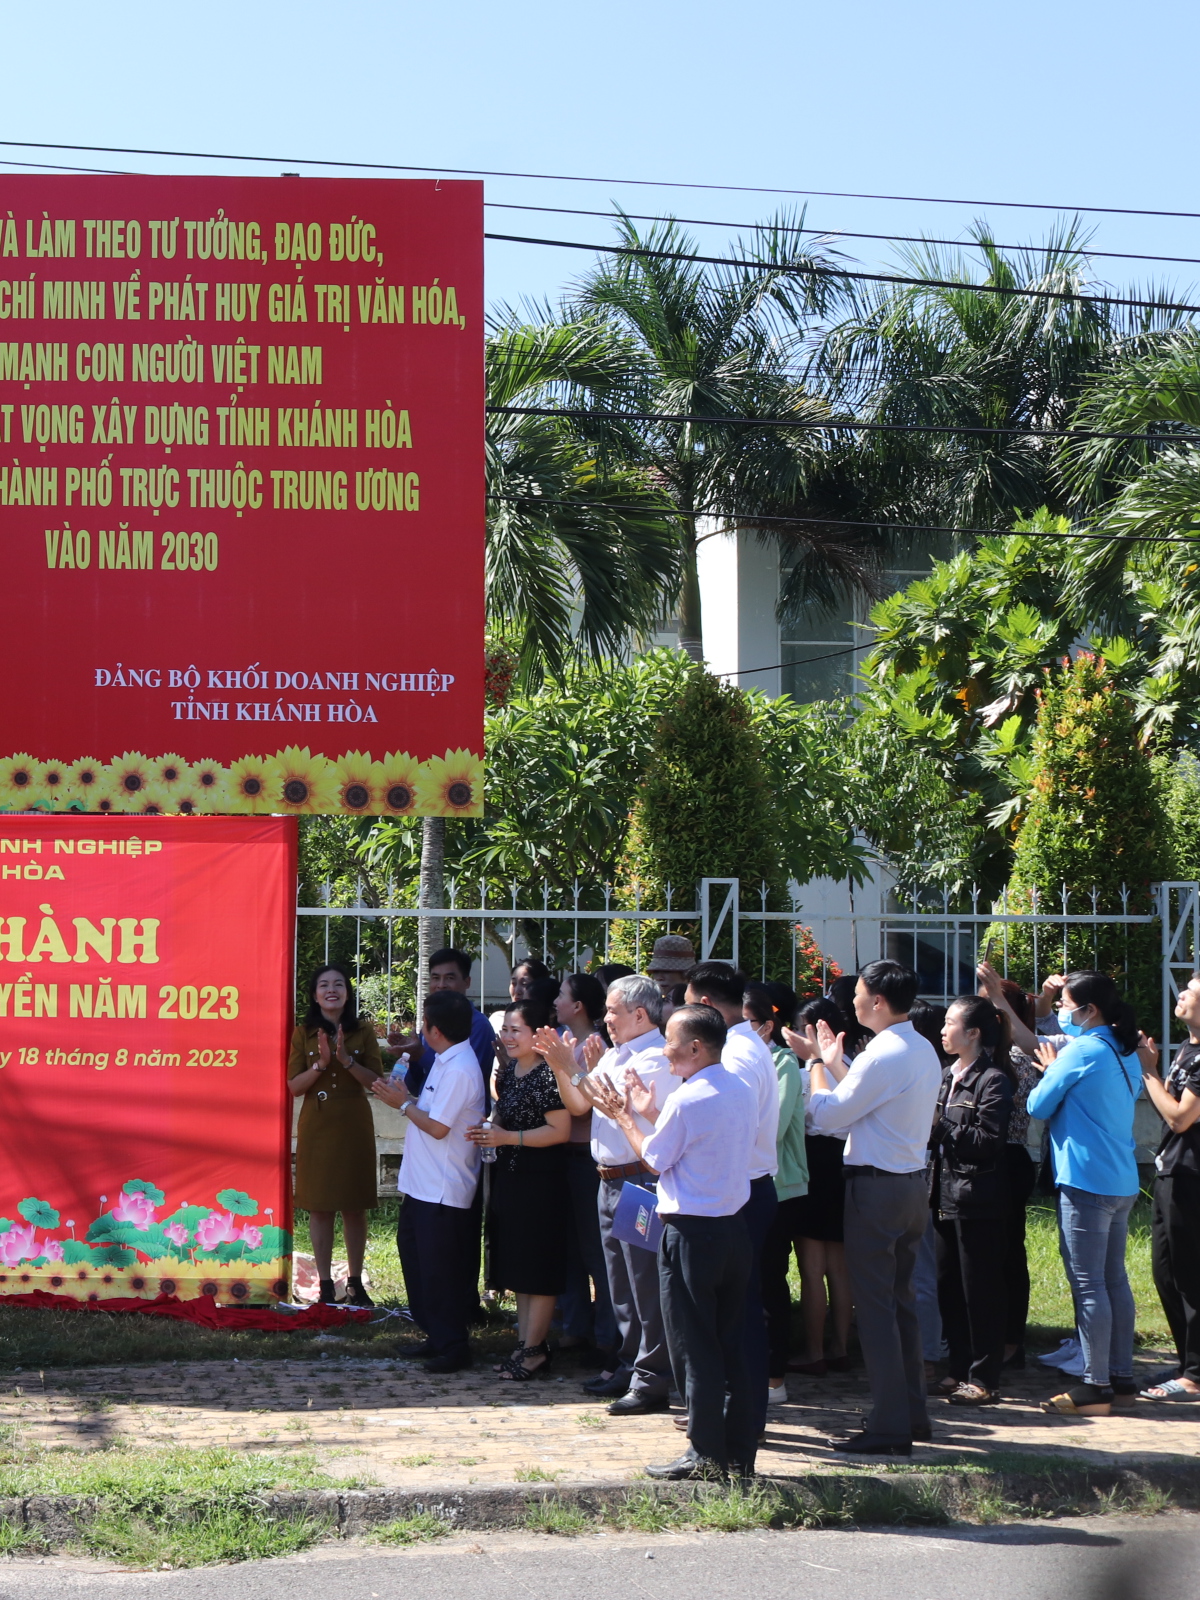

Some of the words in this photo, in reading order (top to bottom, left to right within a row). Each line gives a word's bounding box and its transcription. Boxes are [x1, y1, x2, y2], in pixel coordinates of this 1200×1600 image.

[26, 211, 76, 258] LÀM
[82, 219, 141, 259] THEO
[148, 216, 180, 260] TƯ
[183, 208, 268, 266] TƯỞNG,
[274, 222, 322, 270] ĐẠO
[328, 215, 384, 267] ĐỨC,
[42, 280, 106, 320] MINH
[112, 268, 141, 320] VỀ
[148, 273, 209, 321] PHÁT
[215, 282, 262, 322] HUY
[268, 275, 308, 323] GIÁ
[314, 284, 350, 333] TRỊ
[357, 276, 405, 324] VĂN
[412, 277, 466, 331] HÓA,
[75, 342, 125, 382] CON
[132, 334, 204, 384] NGƯỜI
[211, 336, 261, 393] VIỆT
[267, 345, 323, 385] NAM
[20, 404, 84, 453] VỌNG
[90, 396, 138, 445] XÂY
[144, 401, 209, 454] DỰNG
[216, 393, 270, 447] TỈNH
[277, 399, 358, 448] KHÁNH
[365, 399, 413, 449] HÒA
[65, 453, 114, 507] PHỐ
[119, 464, 180, 517] TRỰC
[186, 460, 263, 518] THUỘC
[270, 470, 348, 511] TRUNG
[355, 467, 420, 512] ƯƠNG
[44, 521, 91, 570] VÀO
[98, 521, 154, 570] NĂM
[160, 531, 219, 572] 2030
[94, 662, 162, 688] ĐẢNG
[167, 664, 201, 693] BỘ
[207, 661, 269, 690] KHỐI
[274, 671, 360, 691] DOANH
[365, 668, 455, 697] NGHIỆP
[170, 695, 230, 721] TỈNH
[235, 697, 322, 722] KHÁNH
[327, 698, 379, 723] HÒA
[1, 859, 66, 881] HÒA
[53, 835, 163, 859] NGHIỆP
[69, 976, 148, 1019] NĂM
[157, 984, 240, 1021] 2023
[18, 1046, 40, 1066] 18
[44, 1047, 110, 1071] tháng
[114, 1048, 129, 1067] 8
[133, 1048, 182, 1067] năm
[185, 1048, 239, 1068] 2023
